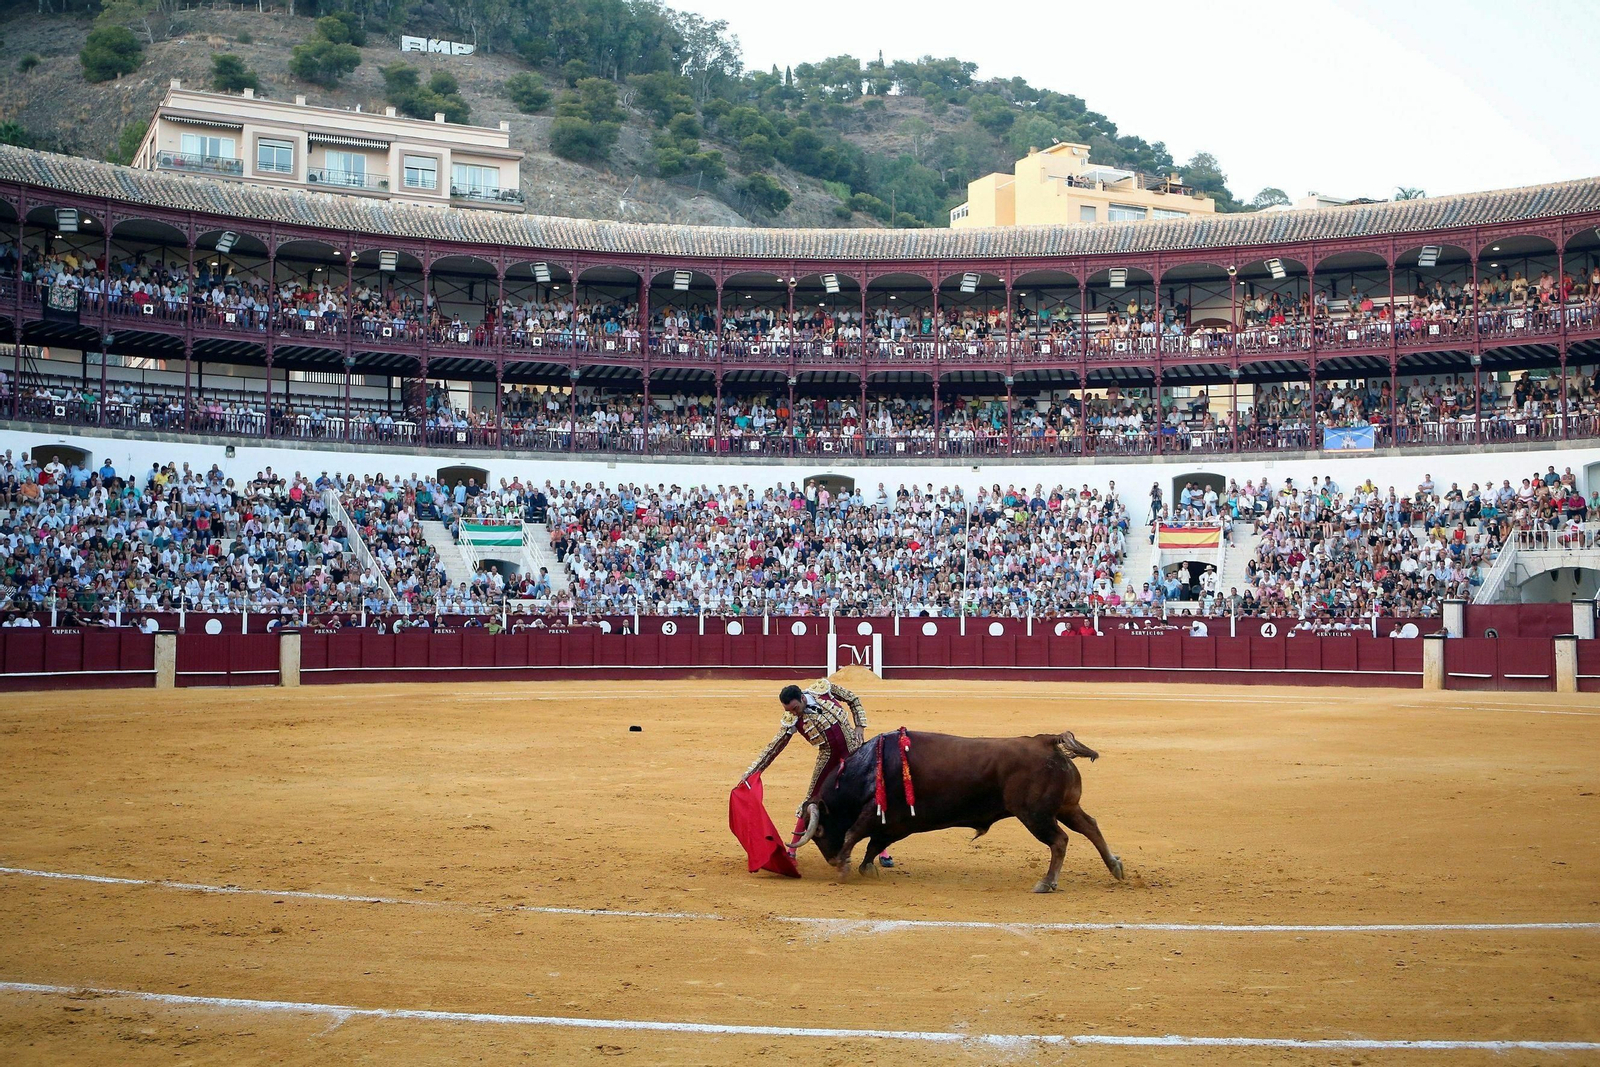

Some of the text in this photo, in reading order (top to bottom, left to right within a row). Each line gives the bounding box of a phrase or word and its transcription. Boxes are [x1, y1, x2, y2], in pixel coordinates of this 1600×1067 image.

[401, 35, 474, 56] AMP
[666, 622, 673, 634] 3
[1264, 624, 1273, 636] 4
[839, 644, 871, 666] M
